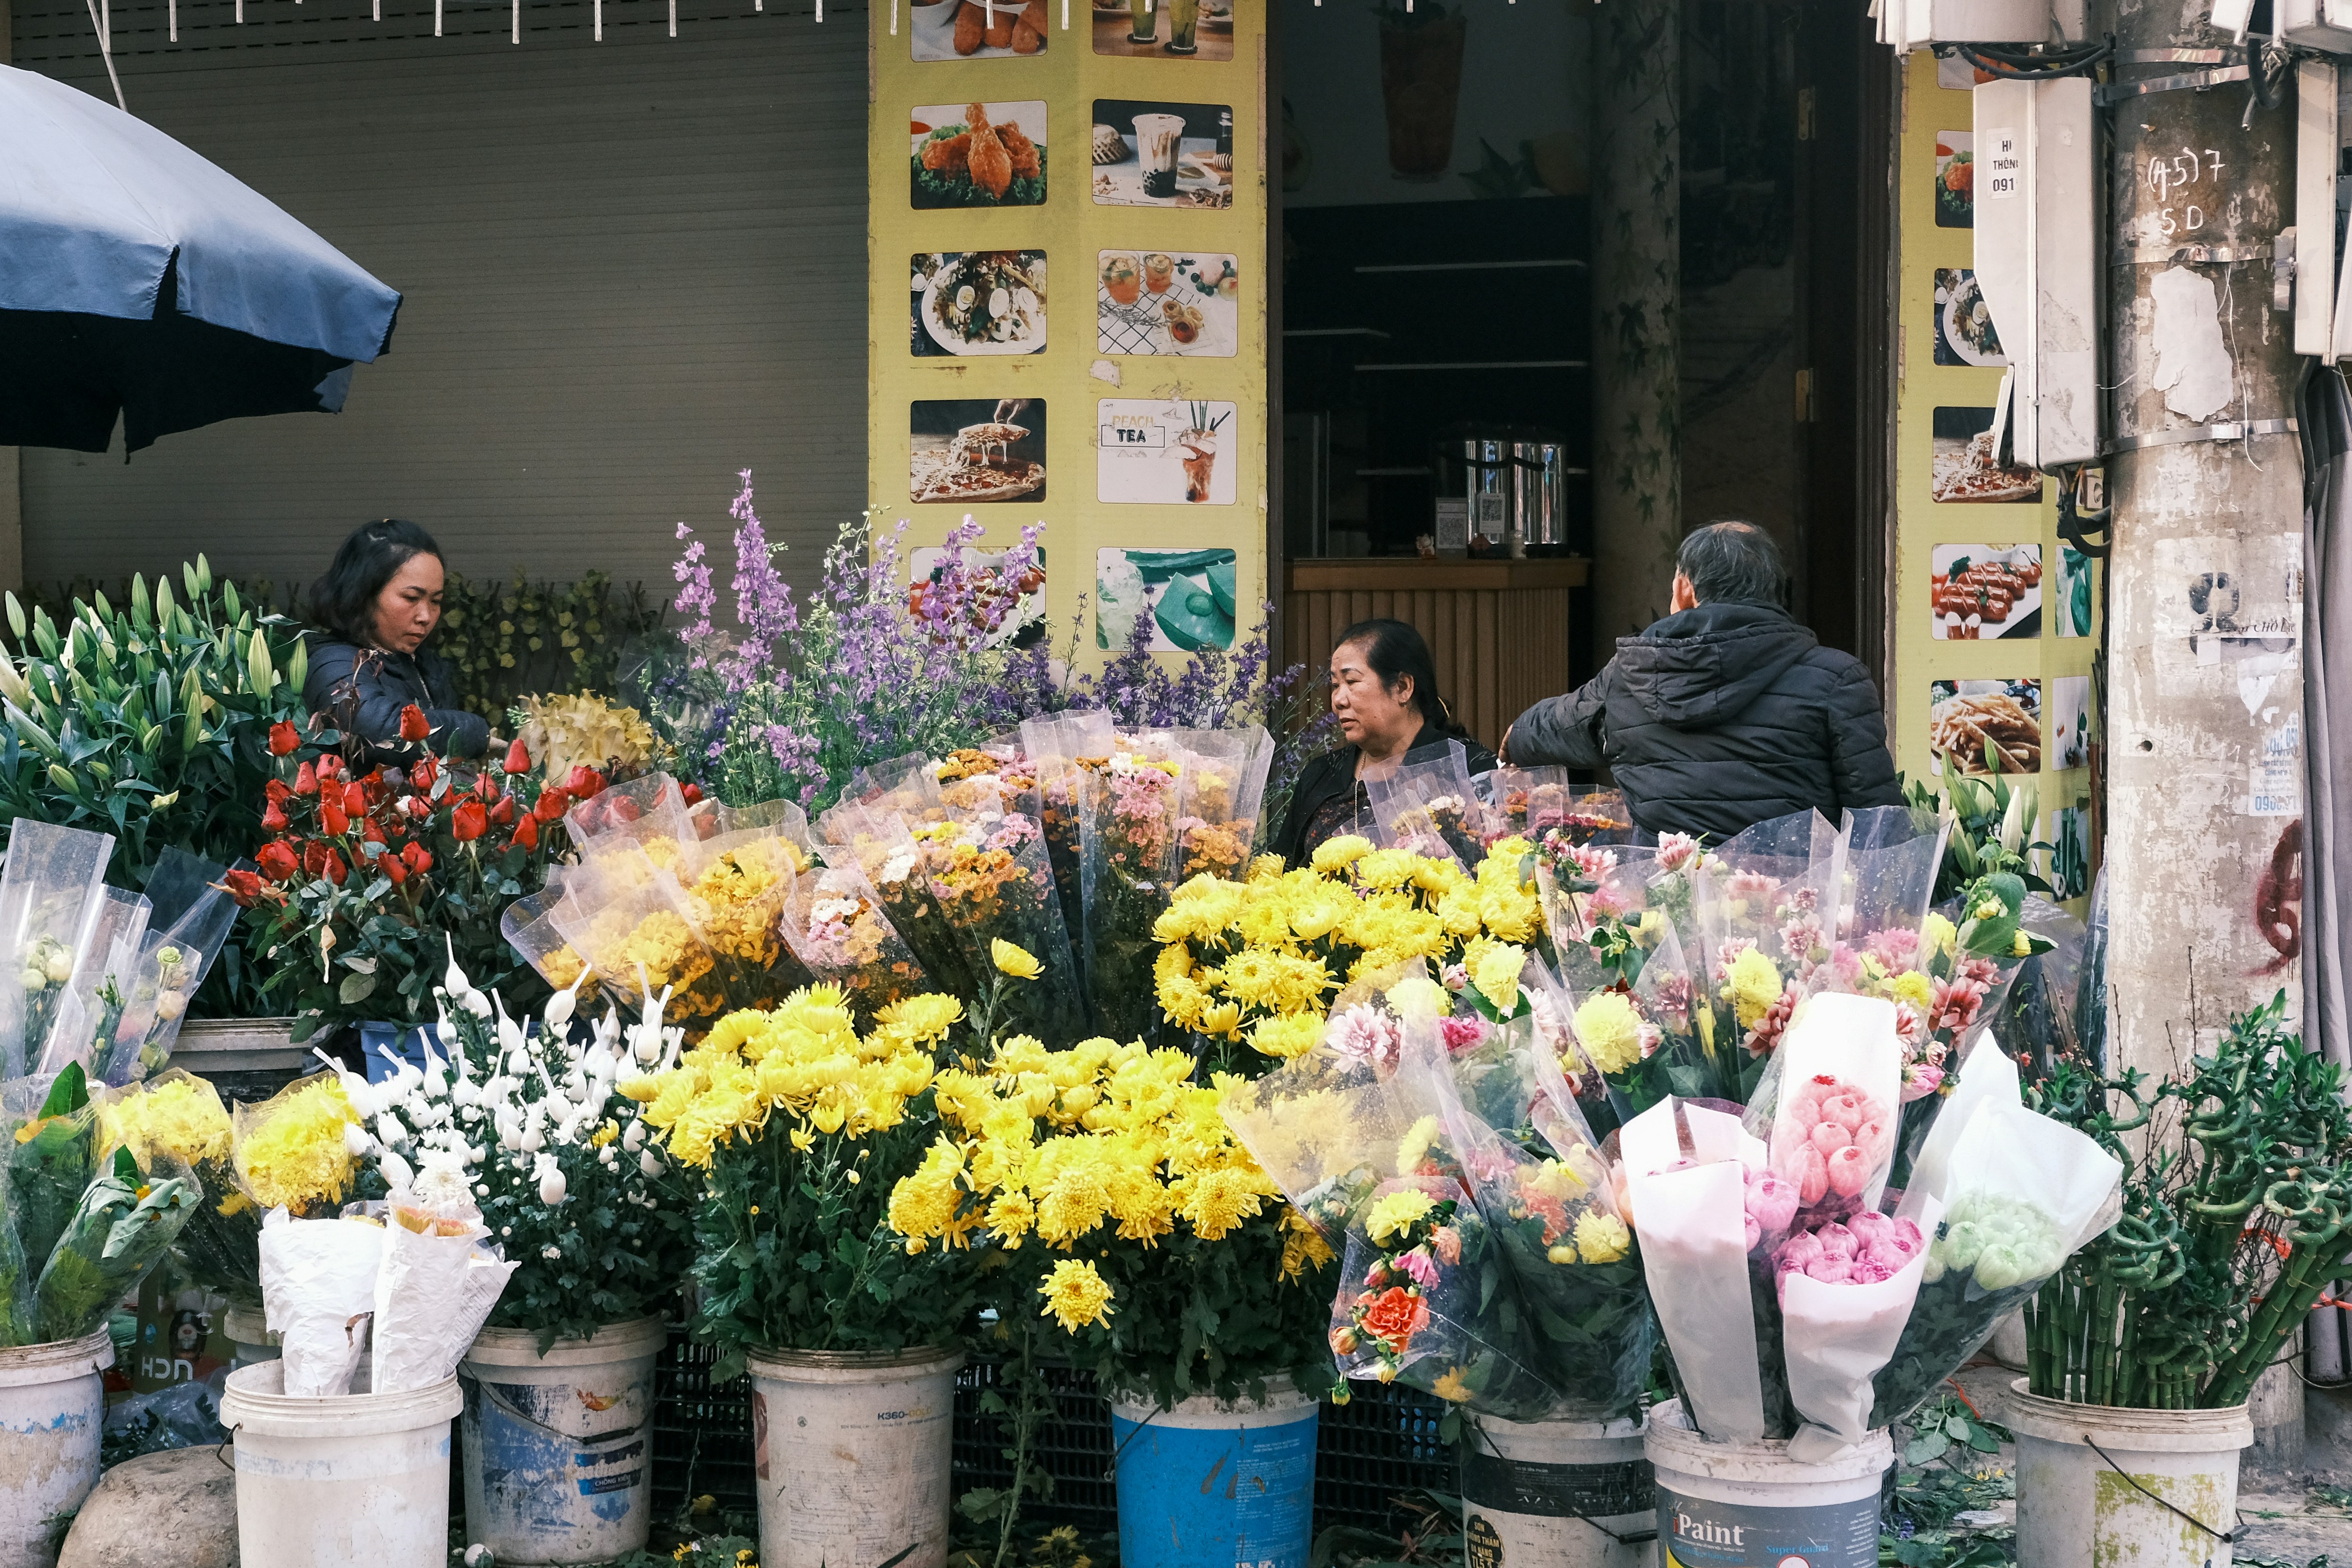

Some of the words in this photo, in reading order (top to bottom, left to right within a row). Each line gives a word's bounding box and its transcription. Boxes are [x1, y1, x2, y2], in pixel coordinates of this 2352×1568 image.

[1993, 157, 2018, 170] THÔN
[2205, 149, 2226, 182] 7
[1112, 415, 1154, 428] PEACH
[1117, 429, 1146, 443] TEA
[1766, 1545, 1796, 1555] Super
[1799, 1543, 1829, 1553] Guard
